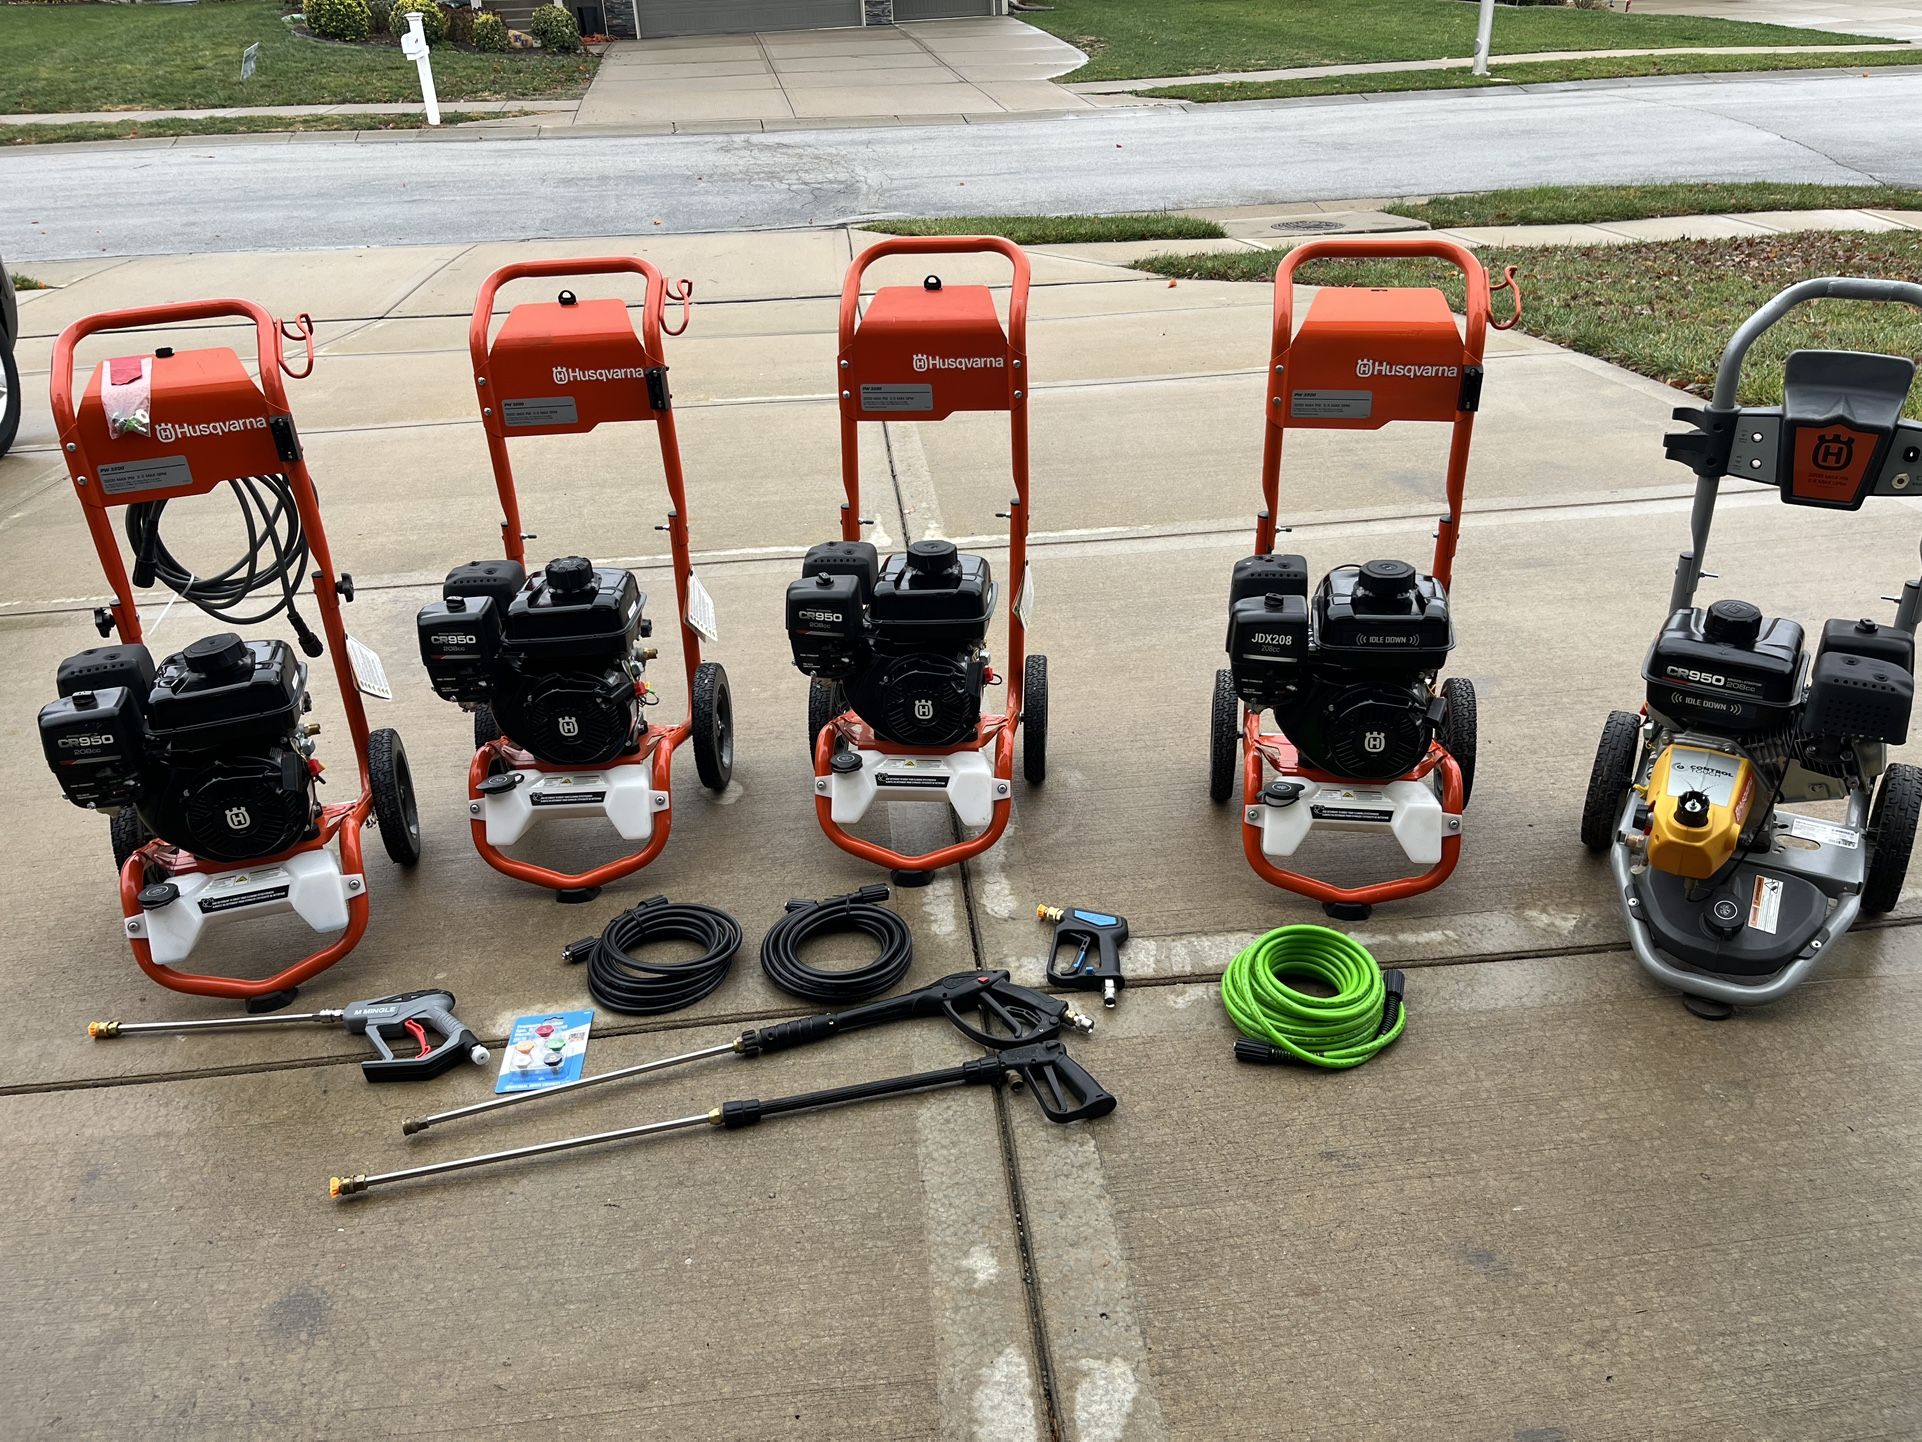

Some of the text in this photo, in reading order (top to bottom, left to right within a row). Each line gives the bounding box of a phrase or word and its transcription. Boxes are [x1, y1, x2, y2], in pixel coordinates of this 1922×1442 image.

[929, 356, 1004, 370] Husqvarna
[1374, 361, 1458, 378] Husqvarna
[569, 367, 645, 382] Husqvarna
[176, 416, 267, 439] Husqvarna
[798, 610, 842, 622] CR950
[430, 635, 476, 644] CR950
[1251, 633, 1292, 645] JDX208
[1385, 636, 1407, 644] DOWN
[1667, 665, 1725, 686] CR950
[1725, 681, 1756, 692] 208cc
[1685, 697, 1727, 711] IDLE DOWN
[58, 734, 114, 748] CR950
[1690, 765, 1734, 777] CONTROL
[1690, 769, 1721, 778] TOUCH
[362, 1006, 396, 1015] MINGLE
